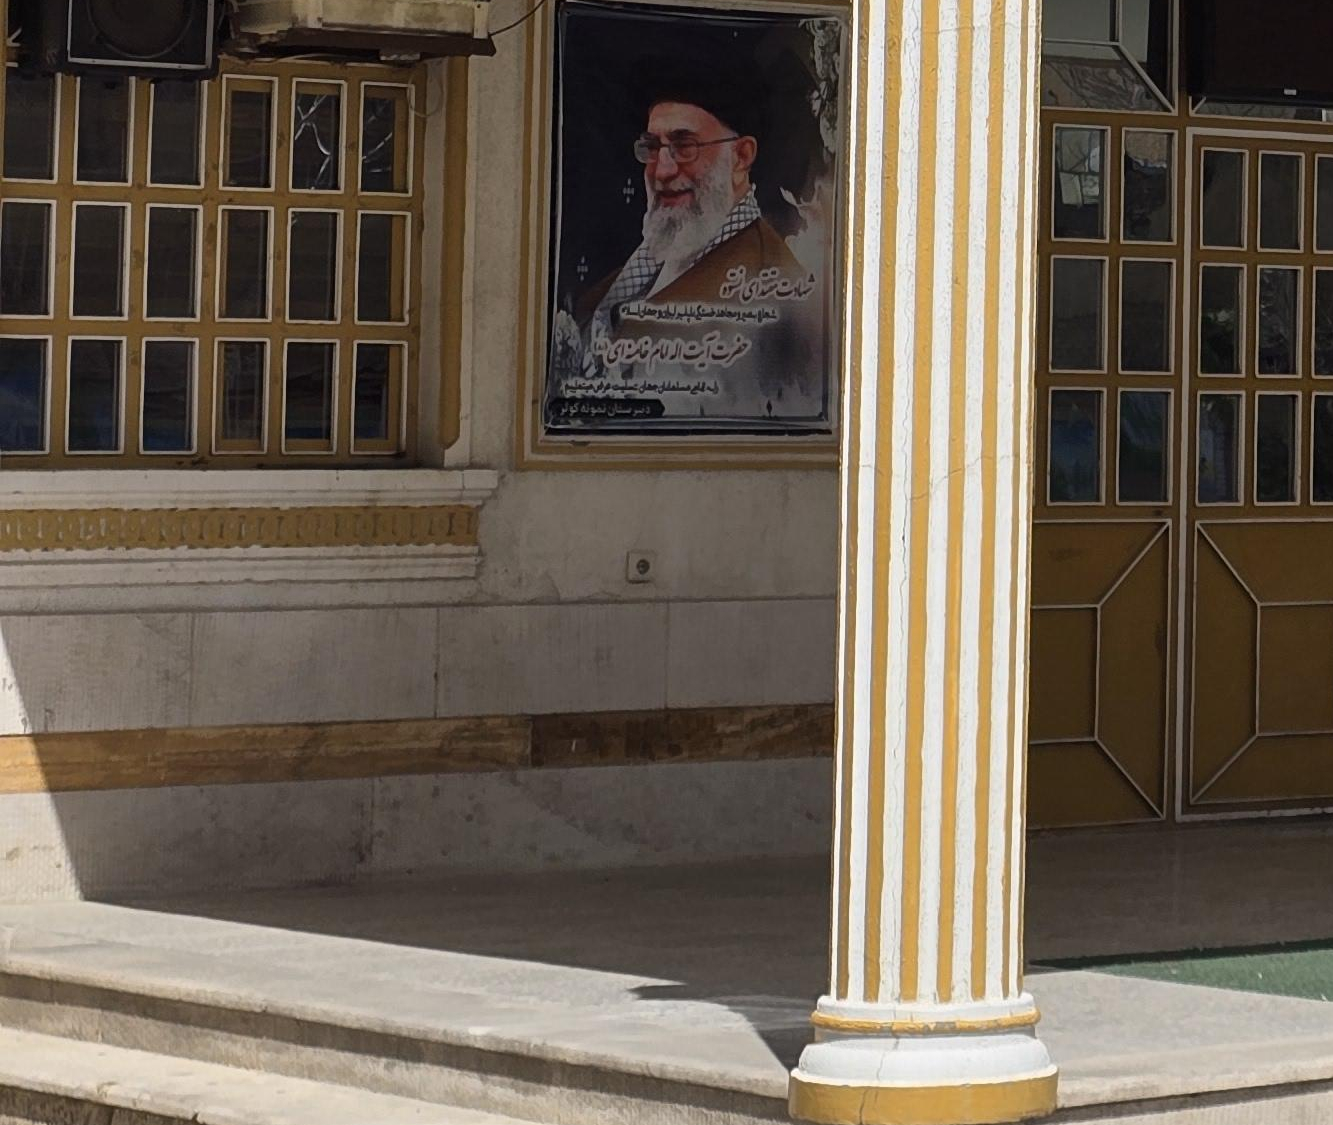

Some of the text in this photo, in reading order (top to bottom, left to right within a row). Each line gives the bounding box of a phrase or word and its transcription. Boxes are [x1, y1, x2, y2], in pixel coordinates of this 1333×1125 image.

[650, 343, 669, 366] امام
[683, 336, 716, 368] آیت
[711, 336, 748, 364] حضرت
